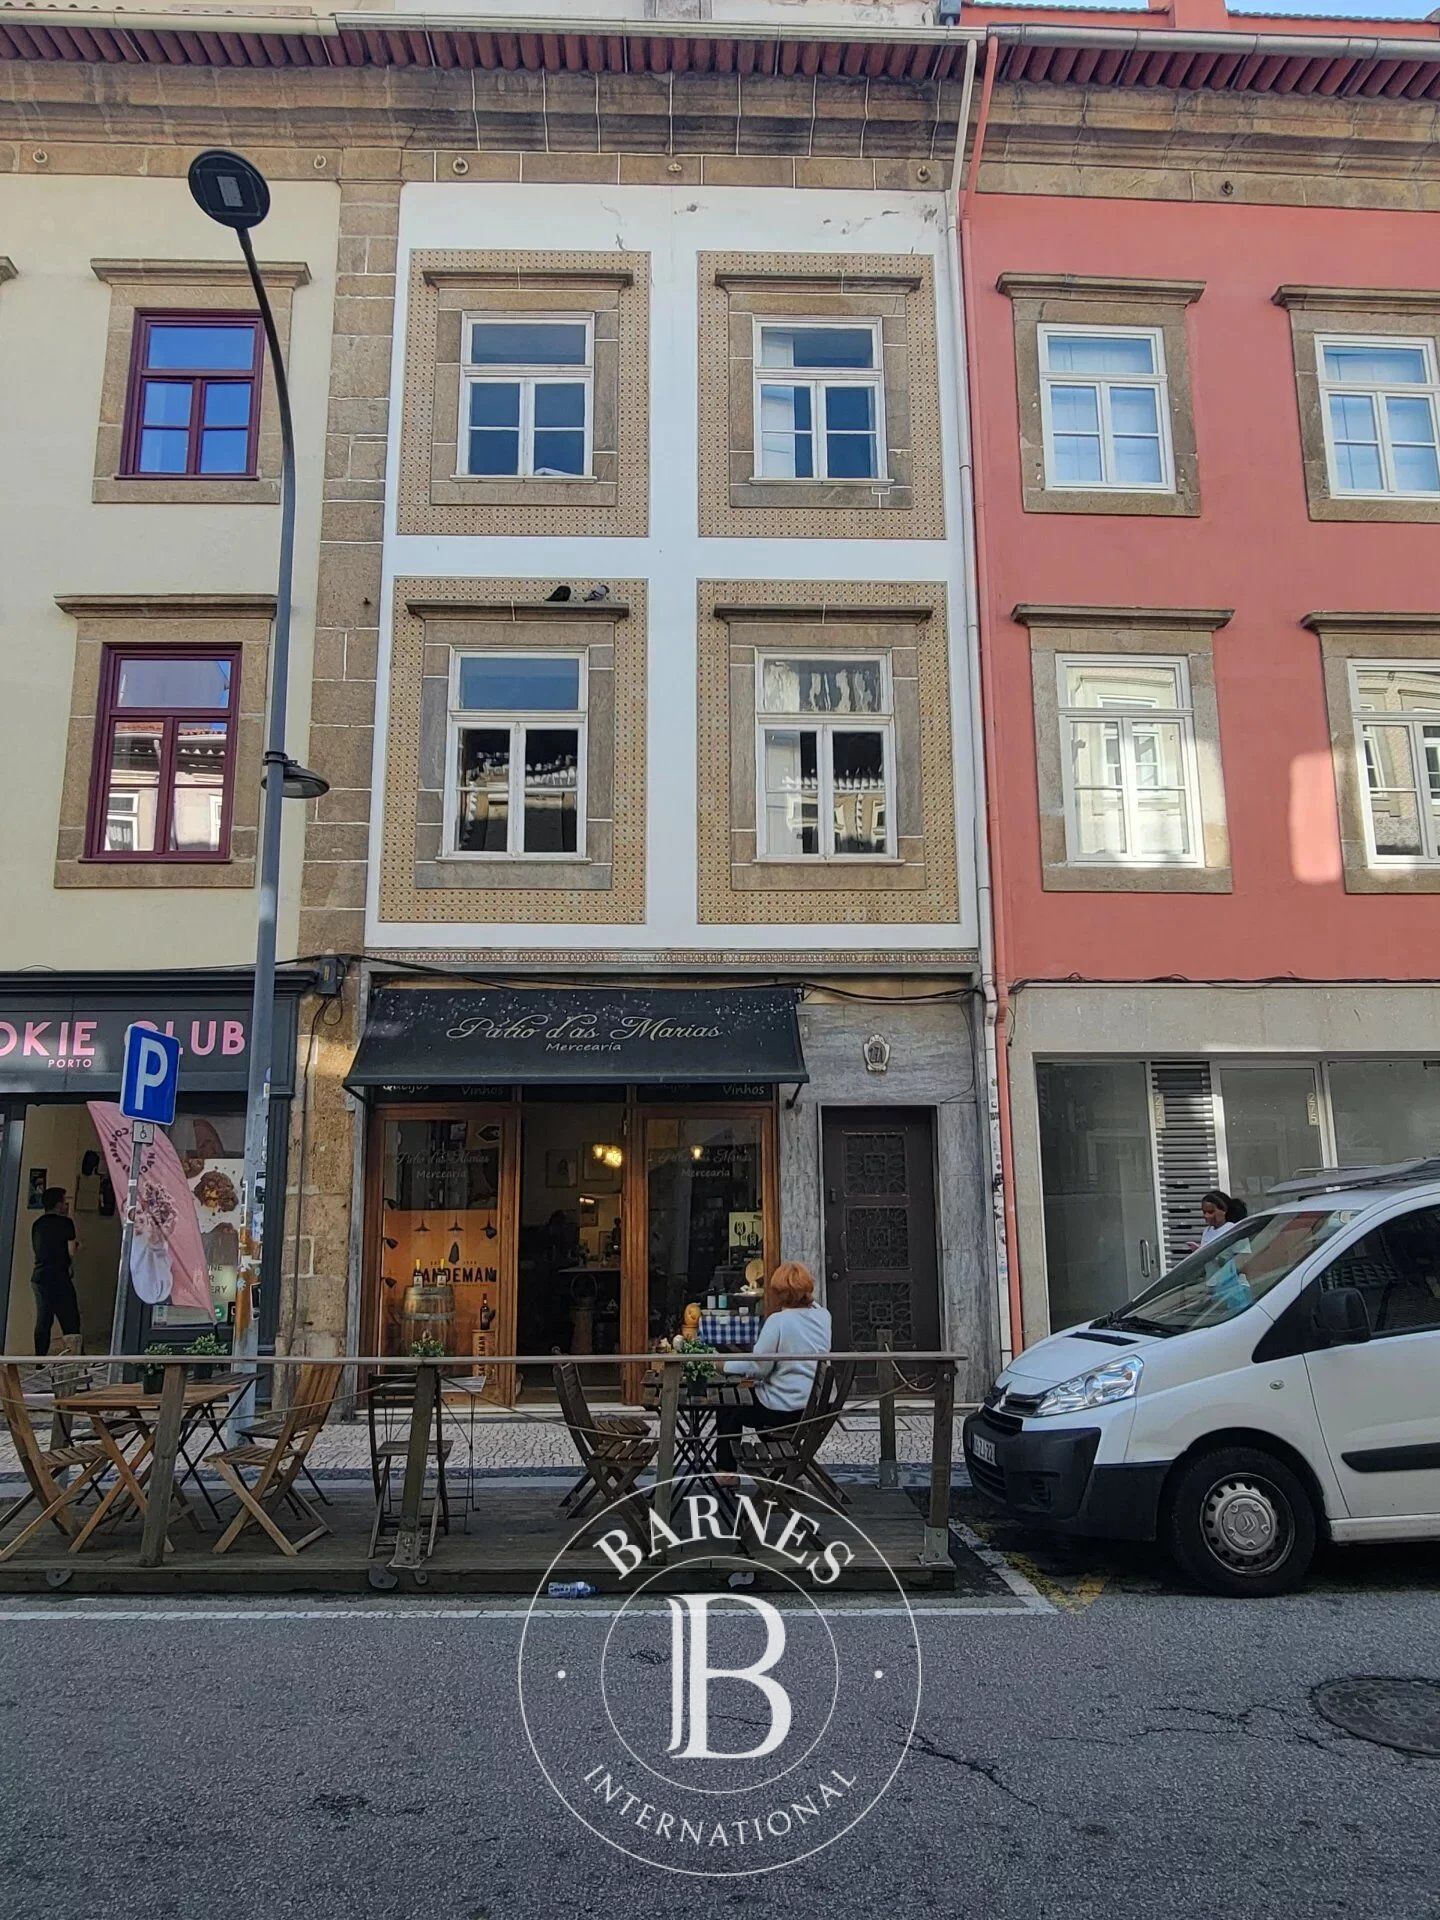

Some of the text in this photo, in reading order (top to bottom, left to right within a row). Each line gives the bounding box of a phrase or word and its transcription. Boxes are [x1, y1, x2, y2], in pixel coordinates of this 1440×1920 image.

[446, 1015, 548, 1040] Pátio
[610, 1015, 722, 1041] Marias
[545, 1041, 622, 1052] Mercearia
[47, 1058, 93, 1069] PORTO
[134, 1037, 169, 1110] P
[461, 1085, 504, 1096] Vinhos
[722, 1083, 765, 1096] Vinhos
[416, 1169, 466, 1179] Mercearia
[681, 1168, 730, 1178] Mercearia
